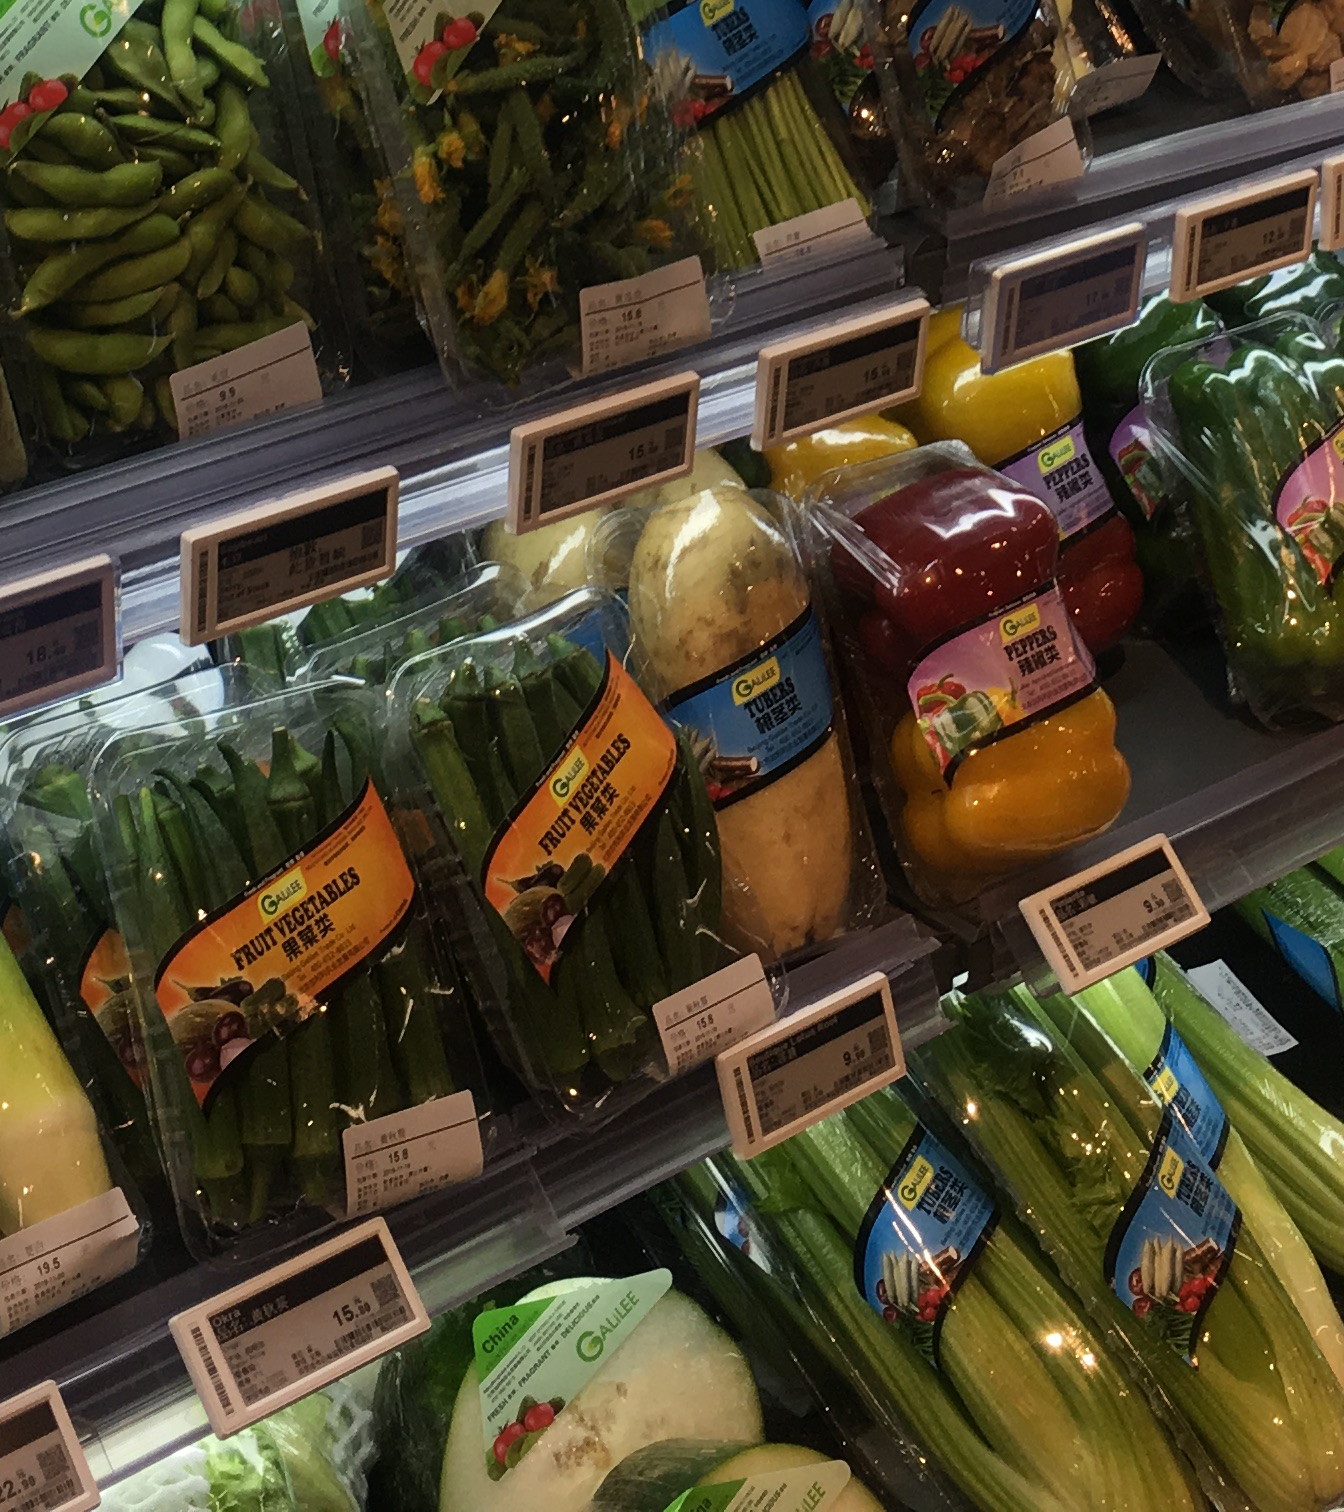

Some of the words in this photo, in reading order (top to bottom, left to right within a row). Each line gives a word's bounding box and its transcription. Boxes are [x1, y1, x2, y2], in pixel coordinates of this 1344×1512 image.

[1003, 624, 1058, 662] PEPPERS
[735, 664, 777, 698] GALILEE
[743, 676, 797, 719] TUBERS
[538, 809, 576, 856] FRUIT
[569, 732, 632, 815] VEGETABLES
[552, 755, 586, 798] GALILEE
[230, 925, 278, 972] FRUIT
[273, 866, 361, 938] VEGETABLES
[260, 879, 303, 916] GALILEE
[388, 1148, 409, 1164] 15.8
[916, 1164, 955, 1216] TUBERS
[36, 1256, 61, 1276] 19.5
[212, 1308, 241, 1329] Okra
[481, 1312, 519, 1355] China
[576, 1289, 640, 1363] GALILEE
[486, 1398, 509, 1423] FRESH
[517, 1349, 552, 1388] FRAGRANT
[560, 1300, 593, 1340] DELICIOUS
